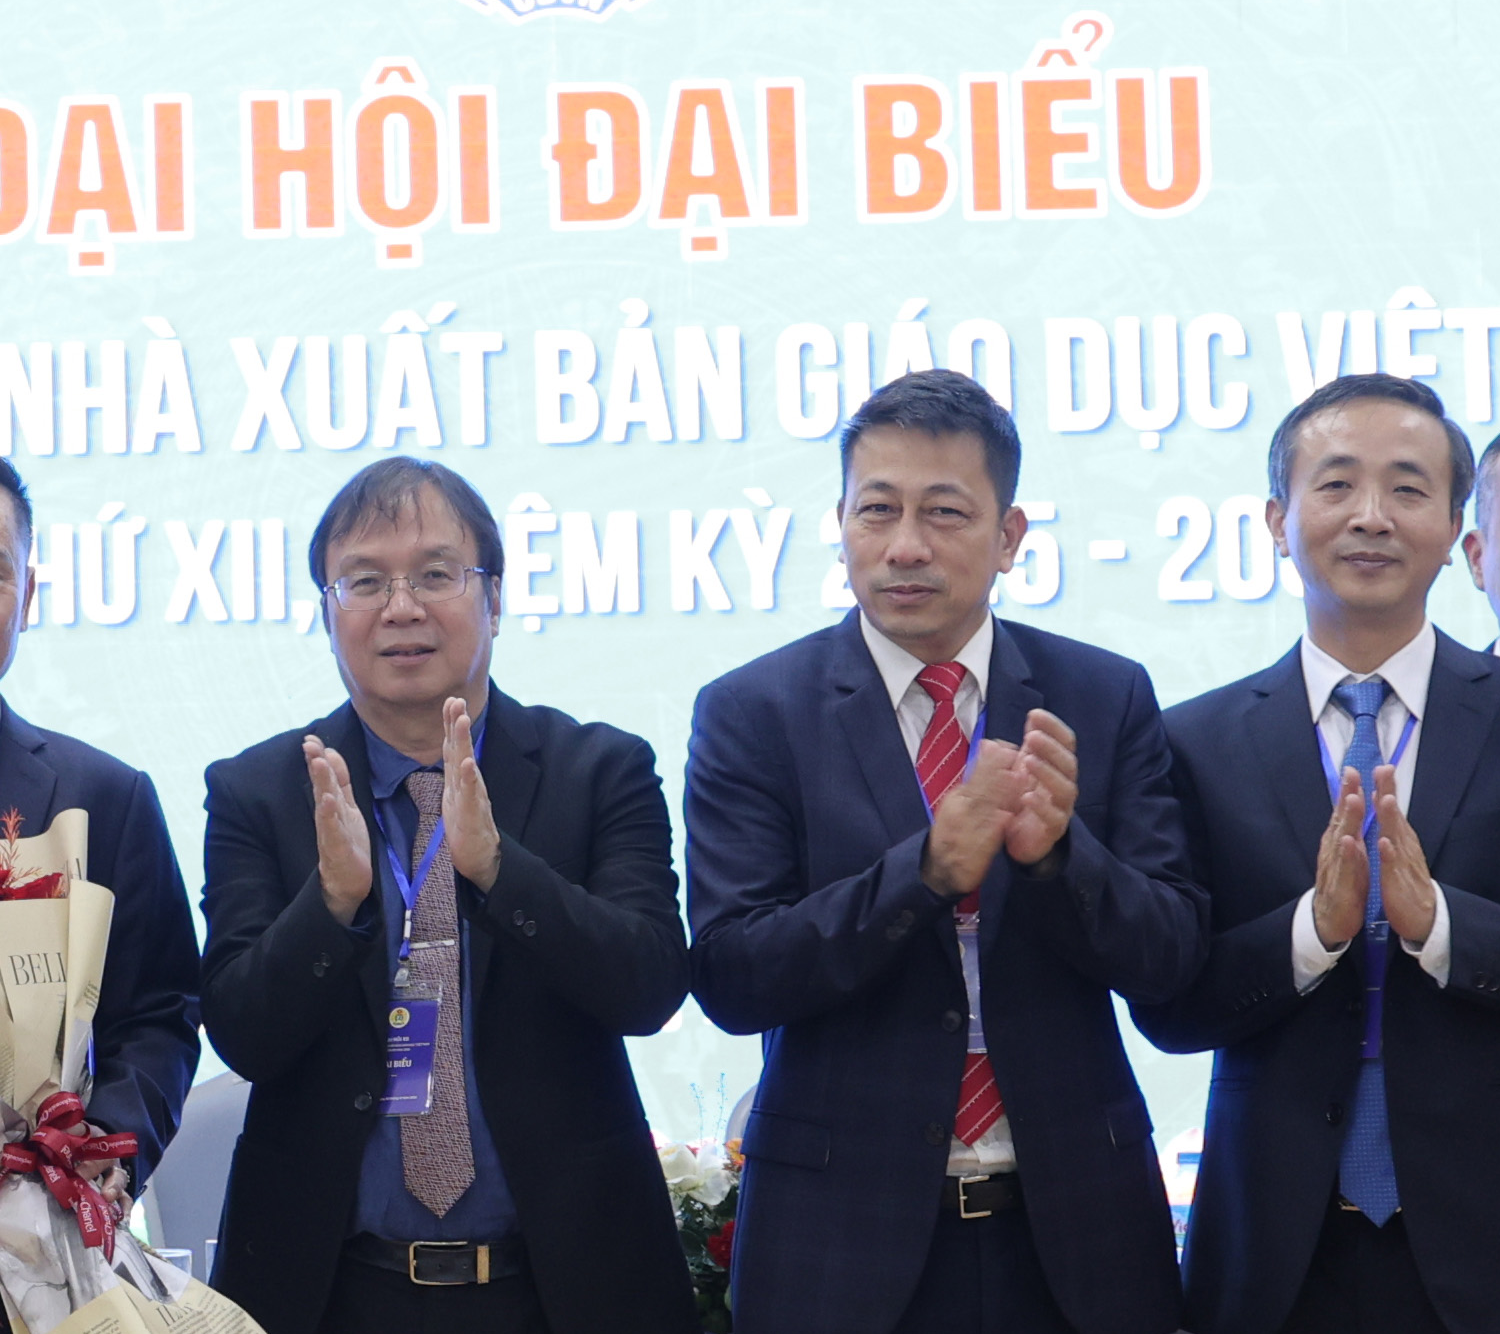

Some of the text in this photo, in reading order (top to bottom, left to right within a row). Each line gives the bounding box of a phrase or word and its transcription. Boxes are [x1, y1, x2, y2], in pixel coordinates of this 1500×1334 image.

[250, 67, 491, 257] HỘI
[552, 86, 799, 251] ĐẠI
[863, 18, 1200, 215] BIỂU
[230, 301, 503, 451] XUẤT
[534, 298, 742, 443] BẢN
[1045, 312, 1249, 450] DỤC
[29, 501, 145, 625] HỨ
[164, 519, 315, 635] XII,
[668, 487, 791, 613] KỲ
[1089, 539, 1125, 560] -
